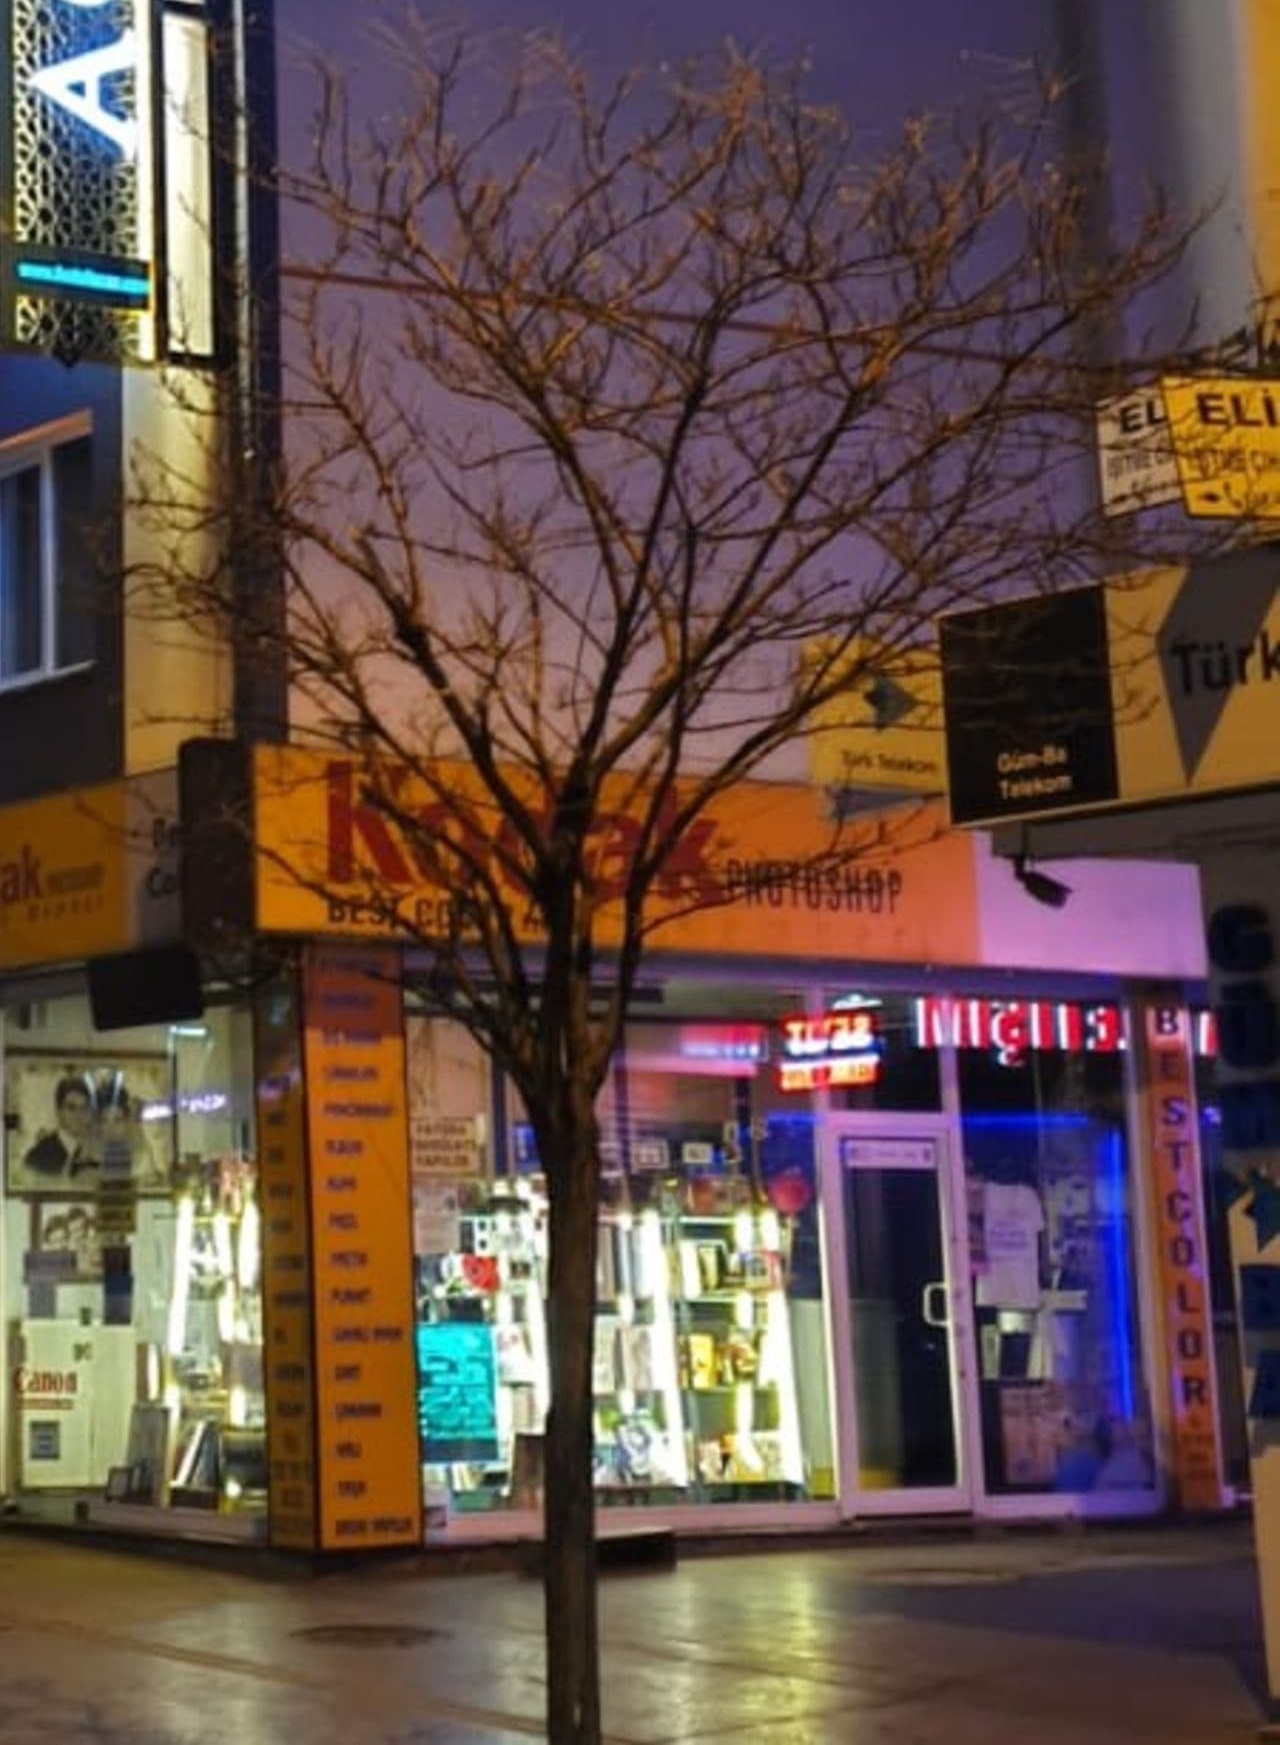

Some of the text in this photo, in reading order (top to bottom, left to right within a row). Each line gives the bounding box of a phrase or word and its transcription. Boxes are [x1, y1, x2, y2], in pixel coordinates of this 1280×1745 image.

[1170, 630, 1280, 696] Türk
[726, 857, 903, 915] PHOTOSHOP
[13, 1365, 78, 1394] Canon
